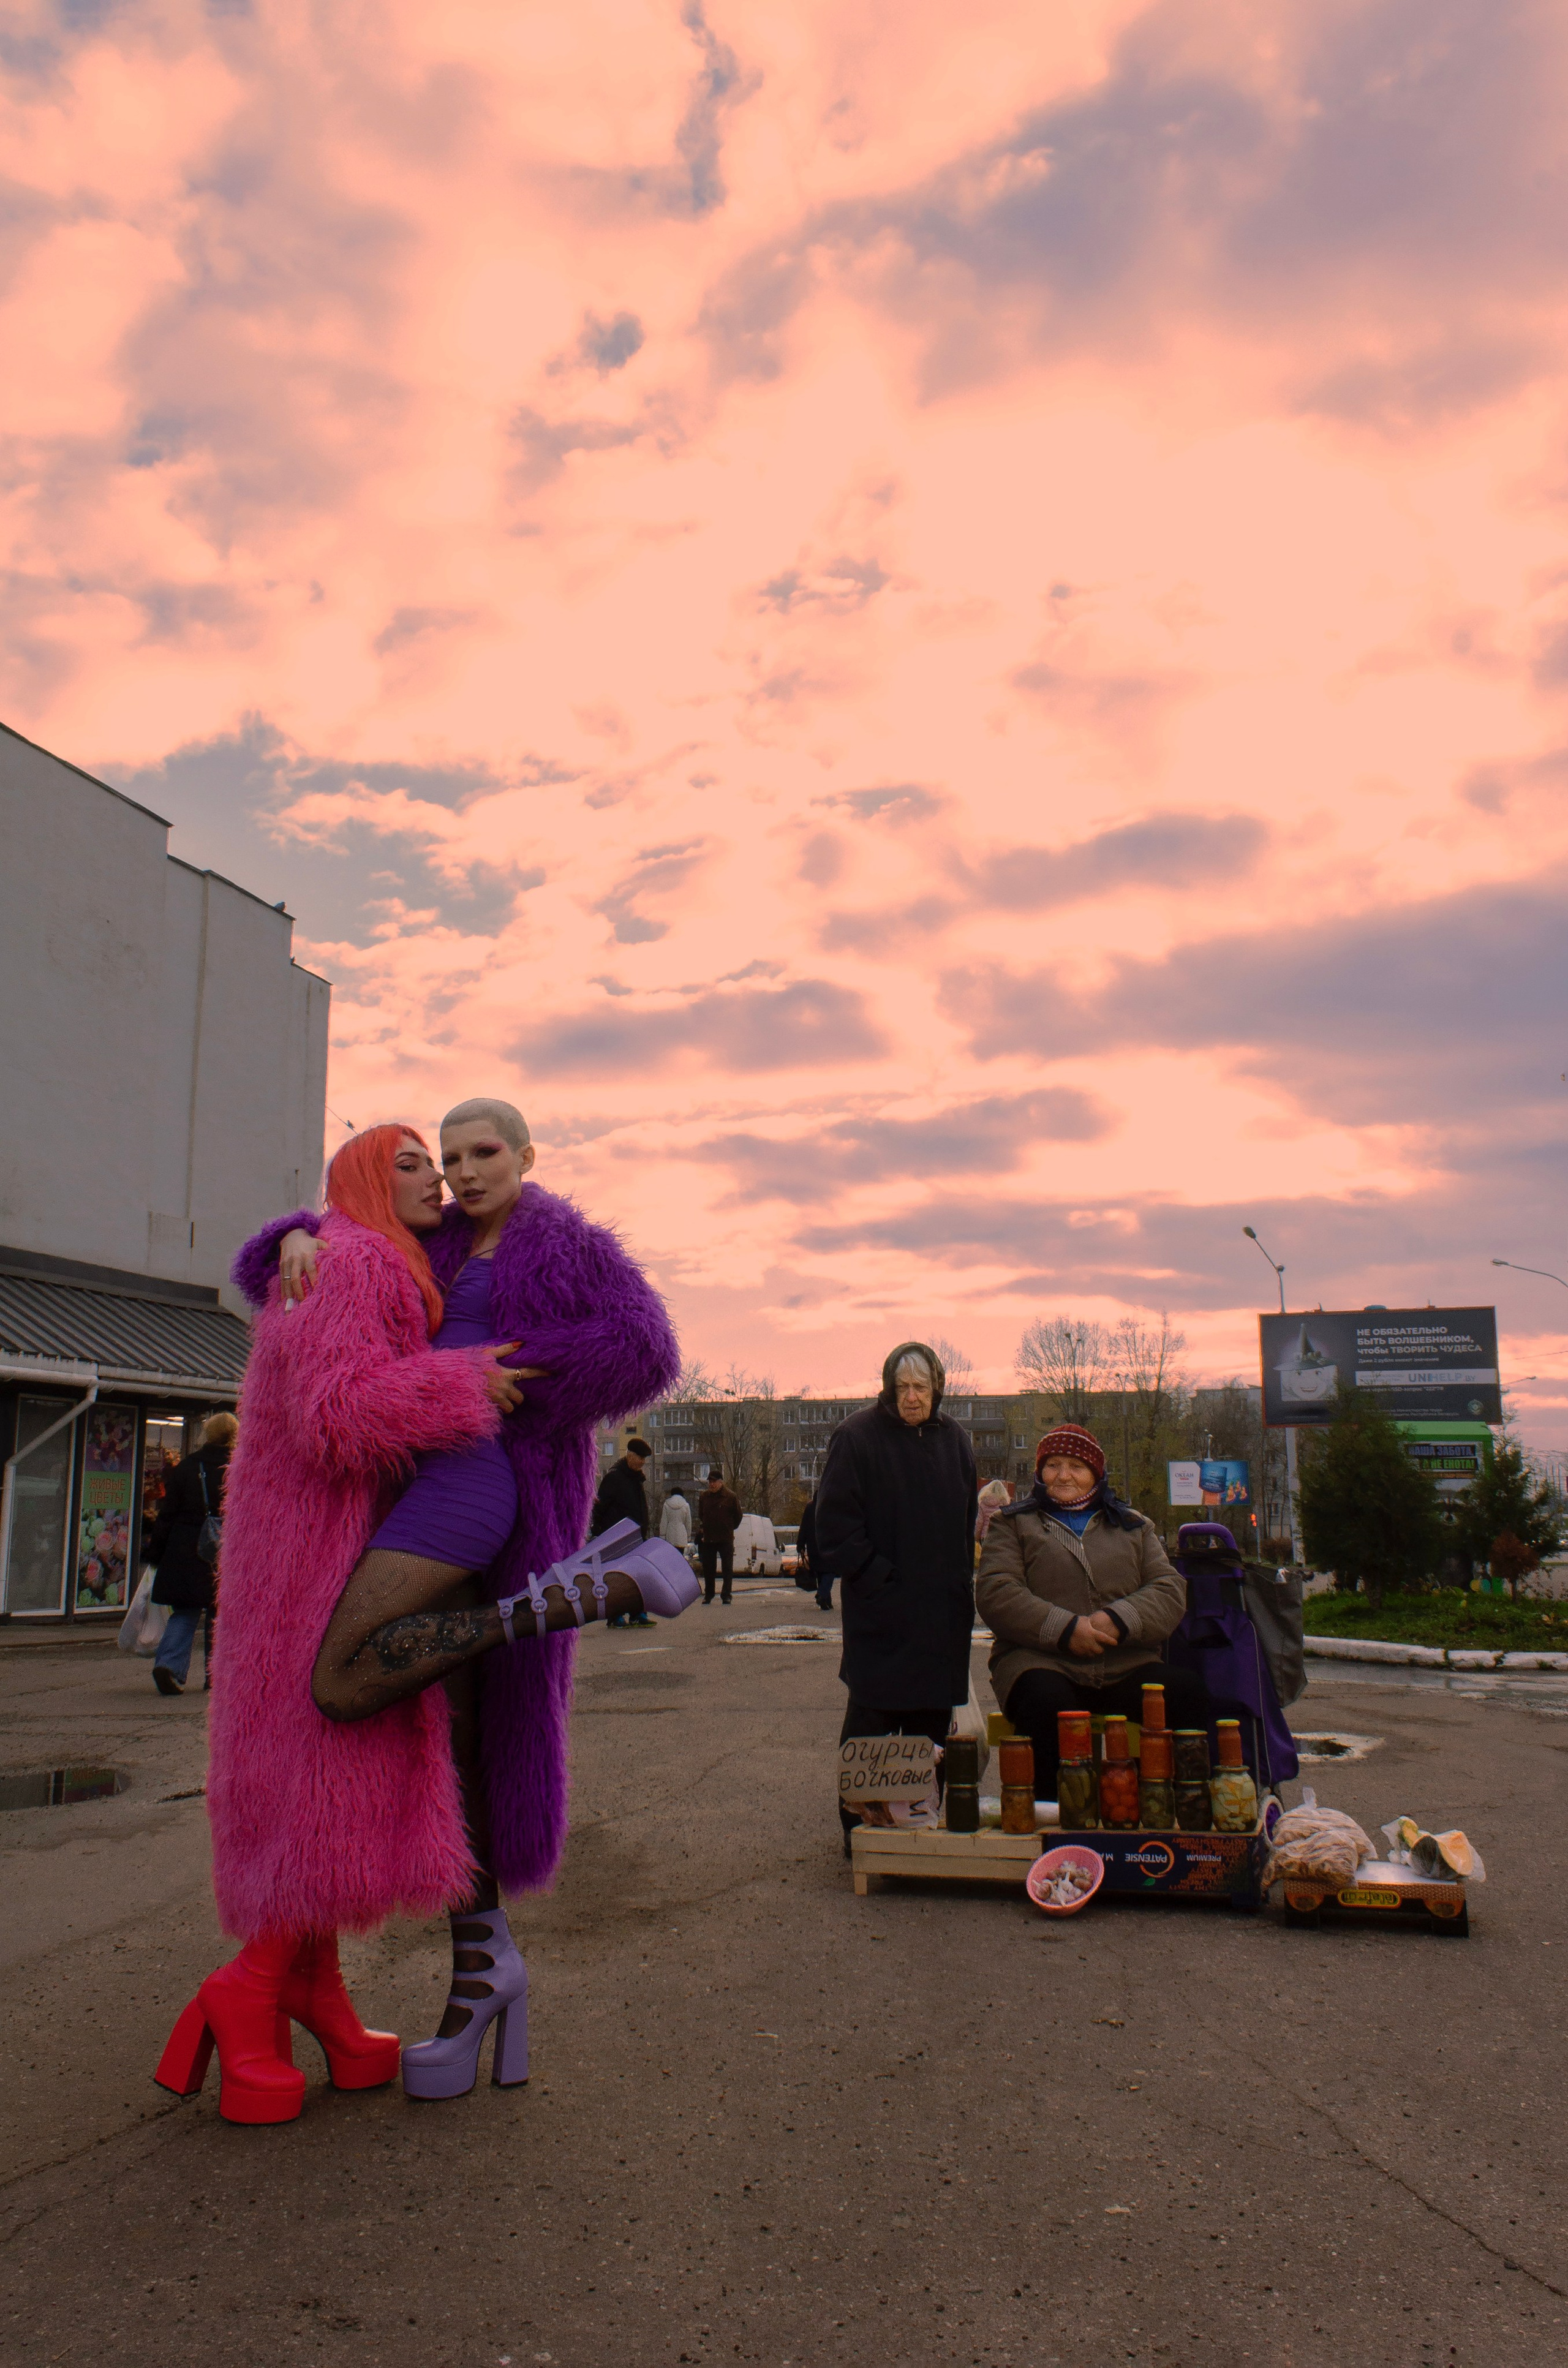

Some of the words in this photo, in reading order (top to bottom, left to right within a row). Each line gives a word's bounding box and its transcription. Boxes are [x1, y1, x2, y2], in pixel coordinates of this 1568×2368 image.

[1373, 1326, 1448, 1335] ОБЯЗАТЕЛЬНО
[1388, 1335, 1474, 1344] ВОЛШЕБНИКОМ,
[1392, 1346, 1438, 1354] ТВОРИТЬ
[1441, 1344, 1482, 1354] ЧУДЕСА
[1431, 1459, 1442, 1469] НЕ
[1443, 1459, 1474, 1469] ЕНОТА!
[89, 1478, 126, 1490] ЖИВЫЕ
[89, 1491, 124, 1505] ЦВЕТЫ
[1125, 1853, 1167, 1863] PATENSIE
